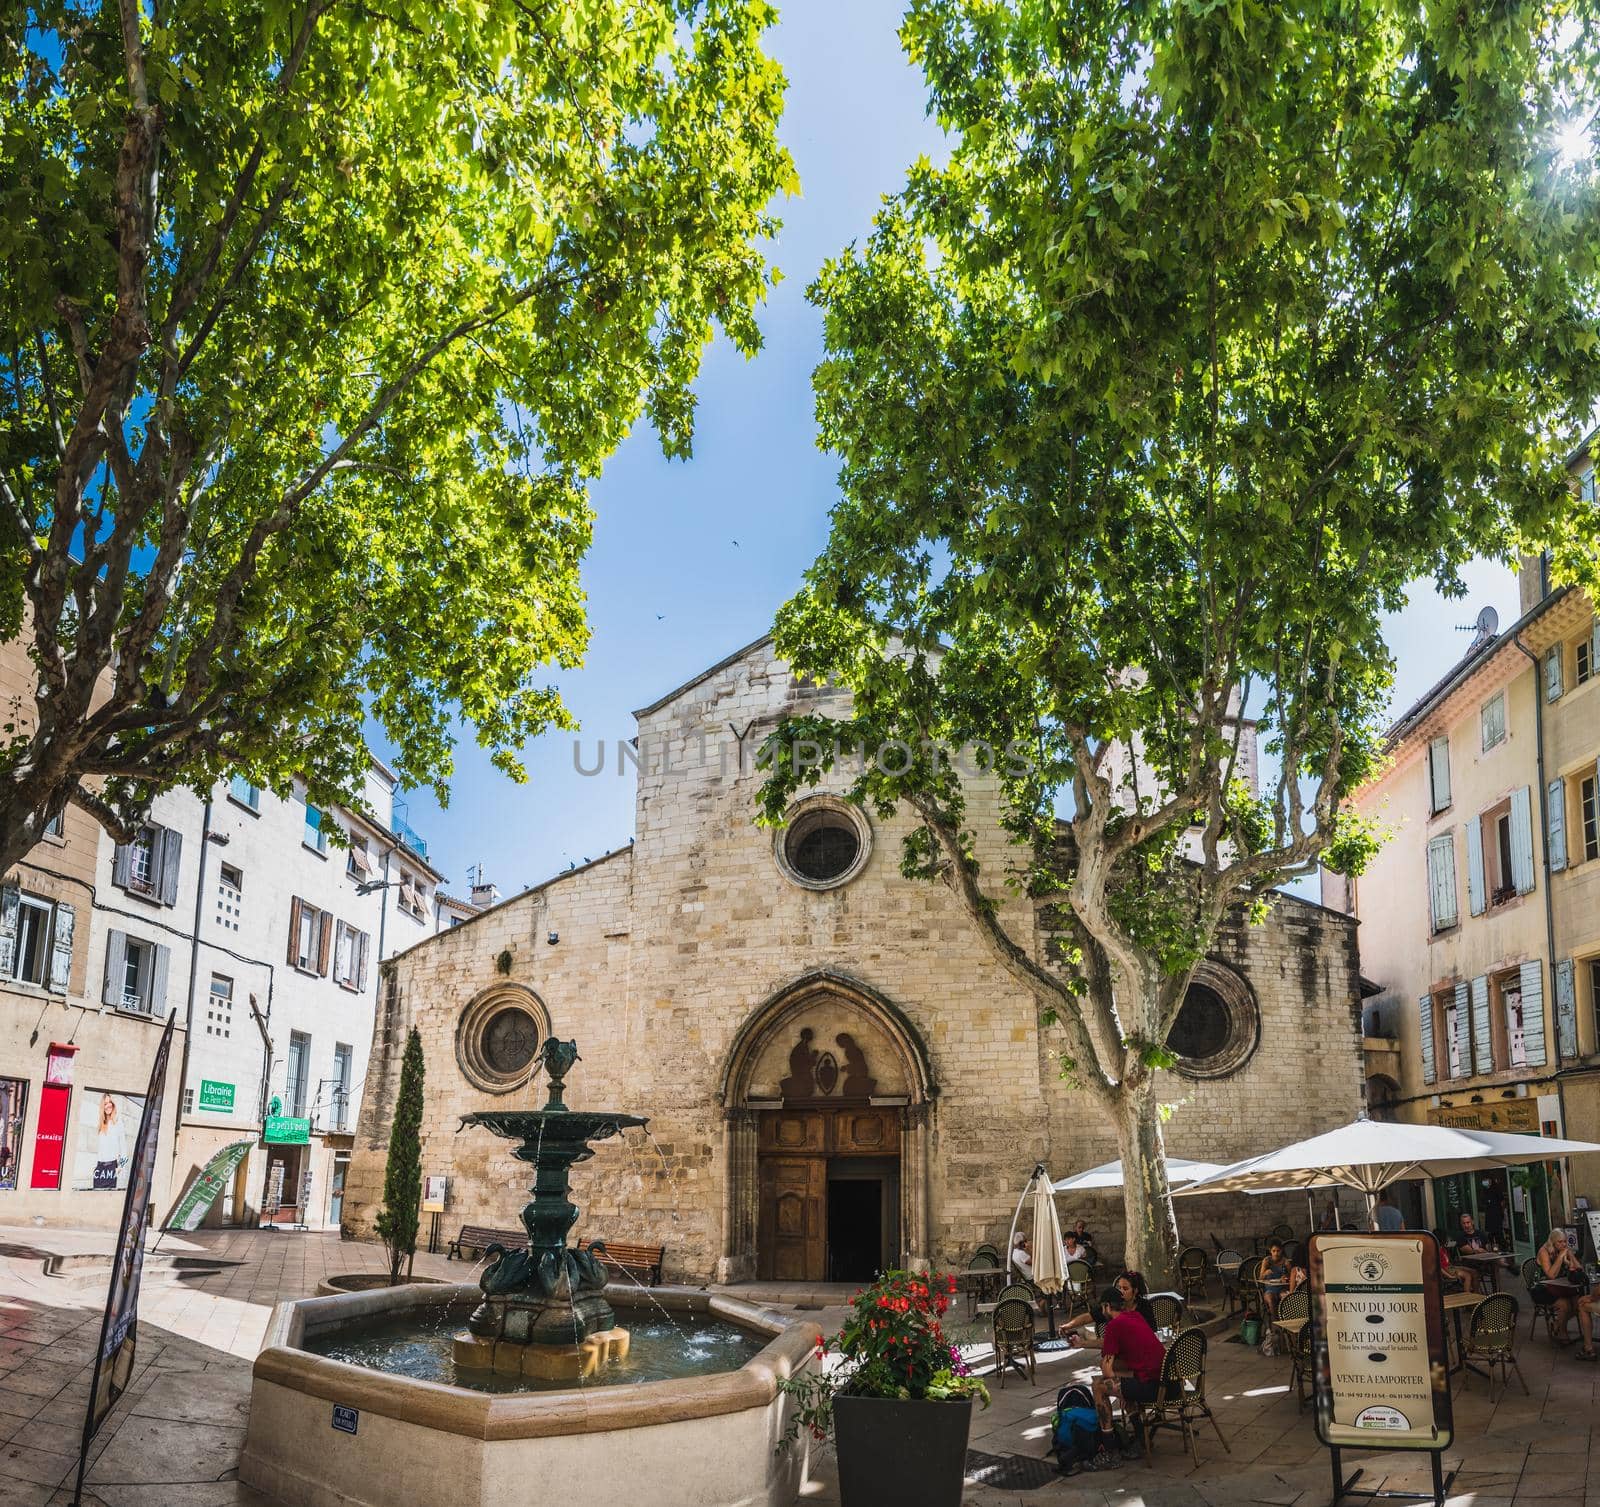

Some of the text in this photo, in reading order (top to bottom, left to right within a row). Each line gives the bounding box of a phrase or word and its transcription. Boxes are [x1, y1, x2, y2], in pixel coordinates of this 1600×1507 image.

[204, 1083, 232, 1096] Librairie
[1332, 1302, 1418, 1313] MENU DU JOUR
[1337, 1331, 1418, 1344] PLAT DU JOUR
[1337, 1374, 1366, 1383] VENTE
[1375, 1375, 1424, 1385] EMPORTER
